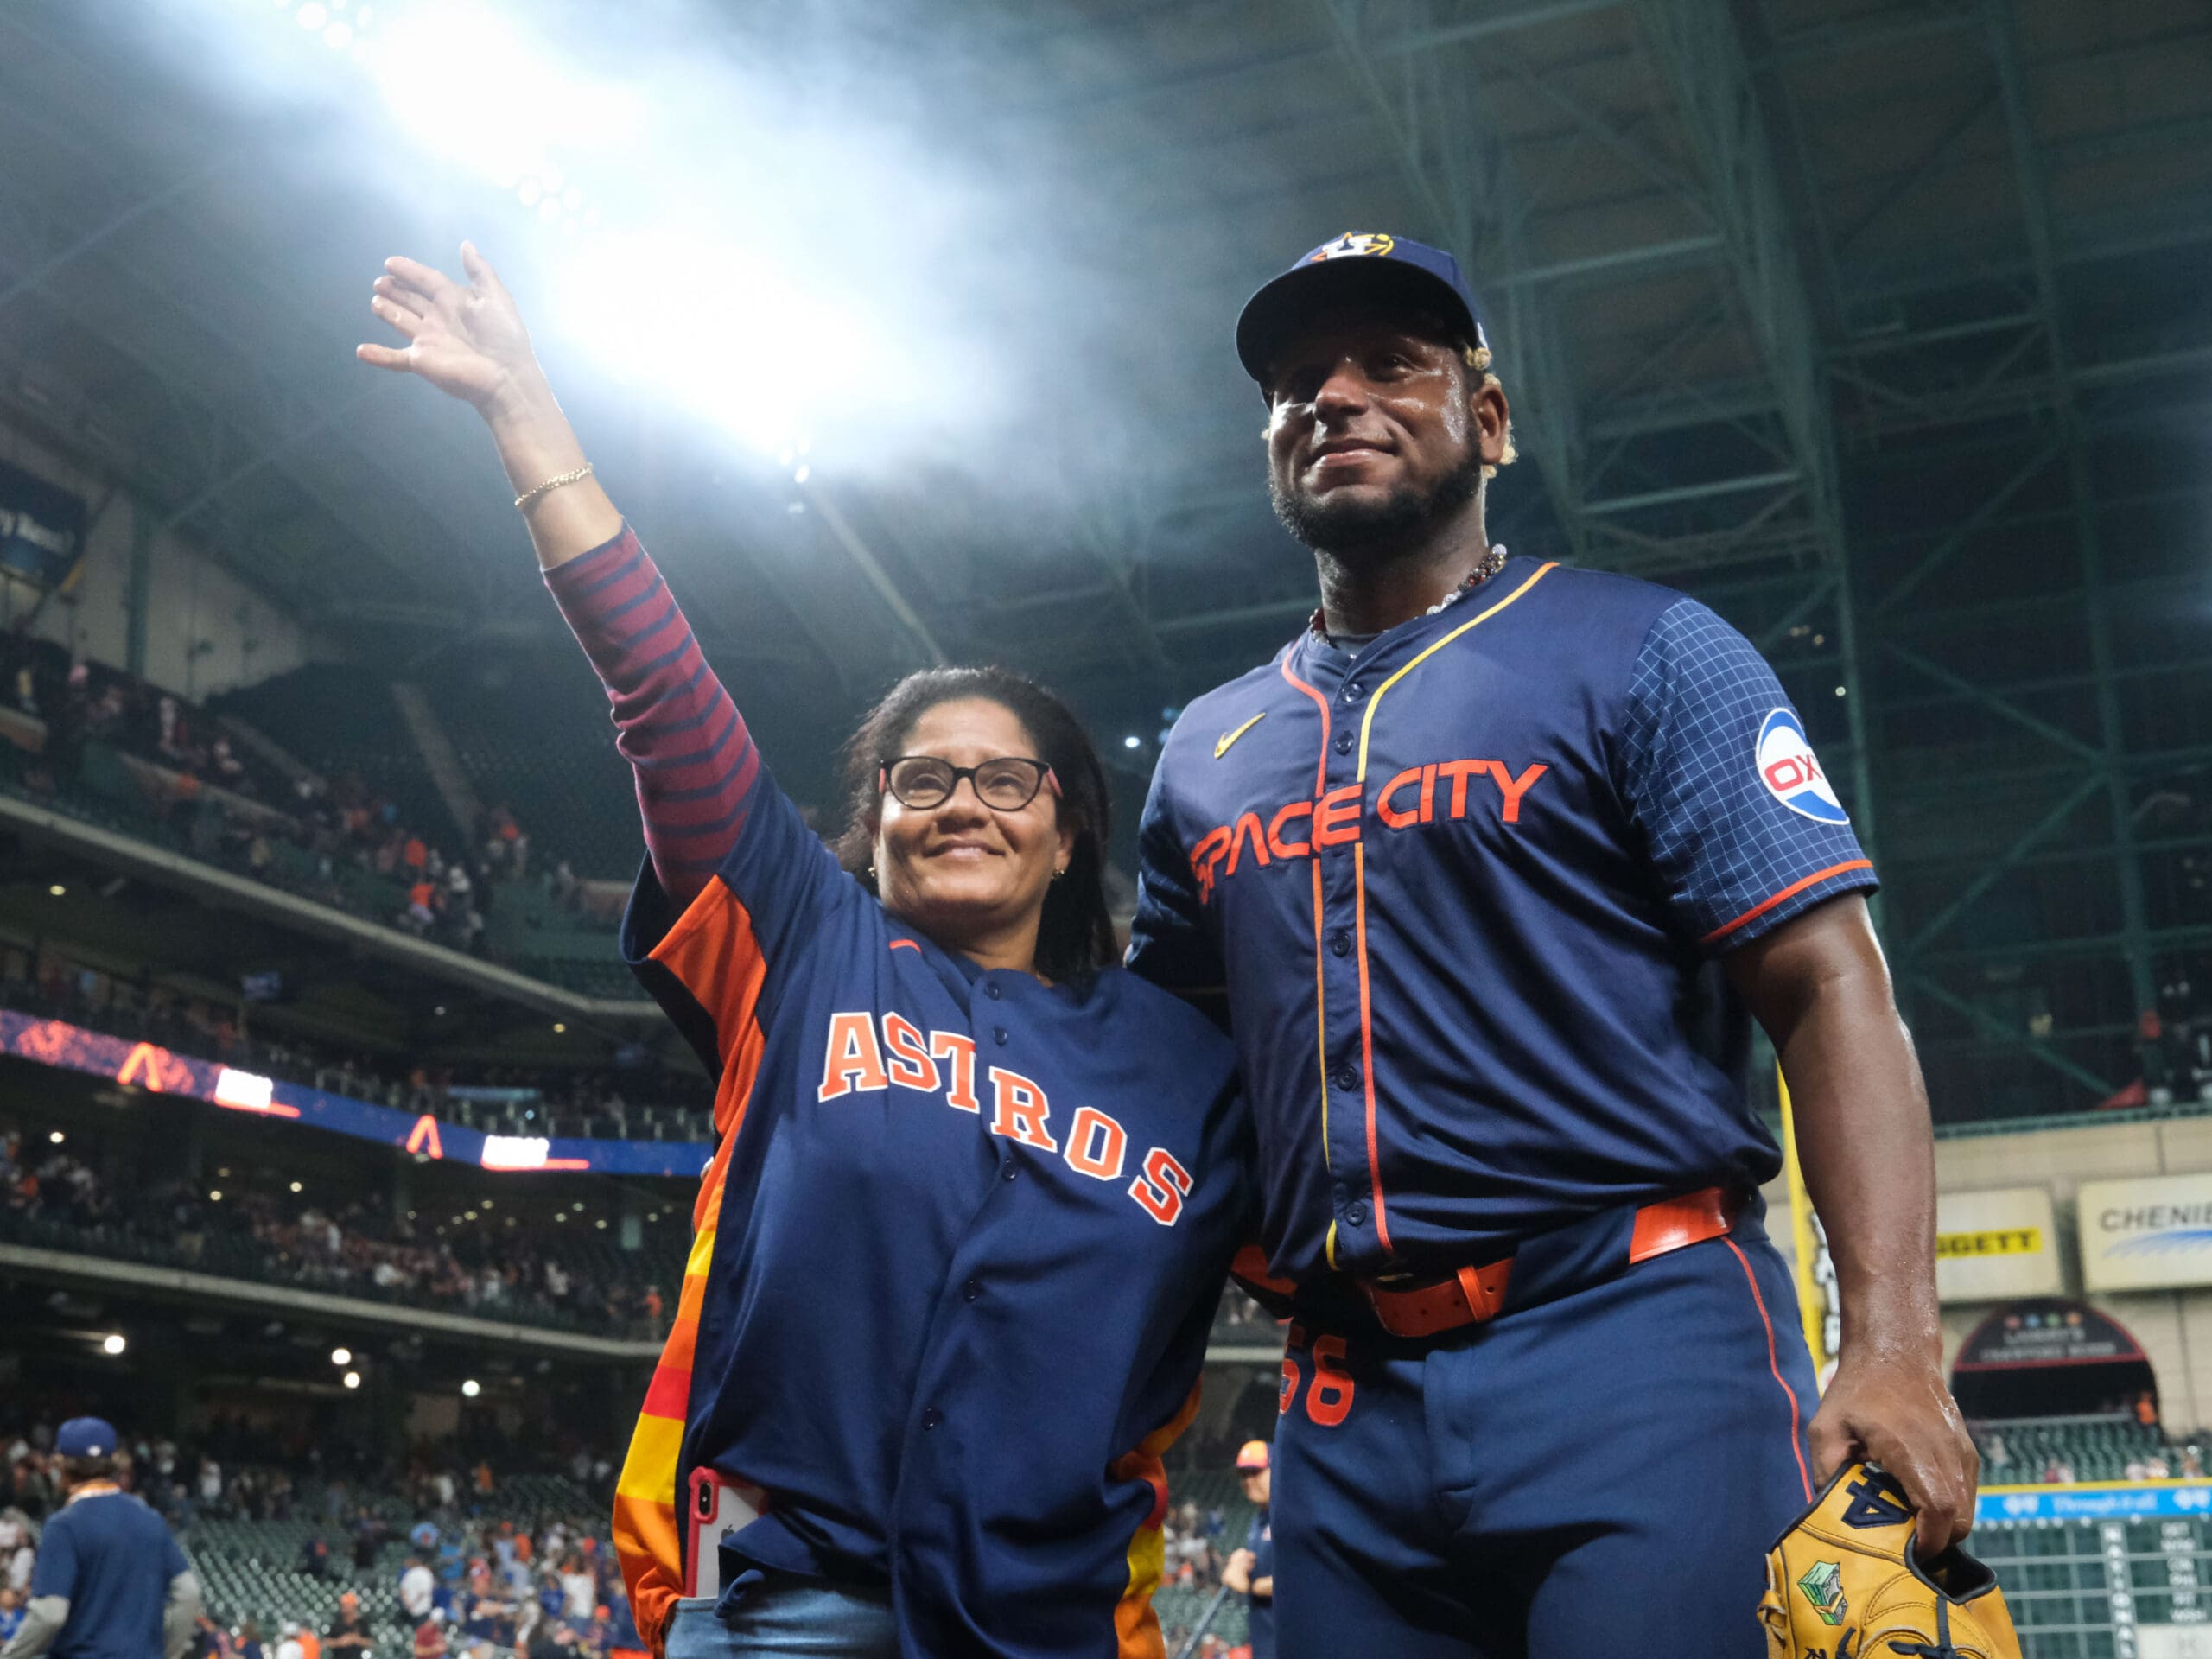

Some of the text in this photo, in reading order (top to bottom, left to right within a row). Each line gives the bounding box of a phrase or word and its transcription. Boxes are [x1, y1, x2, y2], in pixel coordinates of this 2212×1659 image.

[1376, 758, 1548, 830] CITY
[1764, 754, 1823, 792] OX
[817, 1011, 1194, 1227] ASTROS
